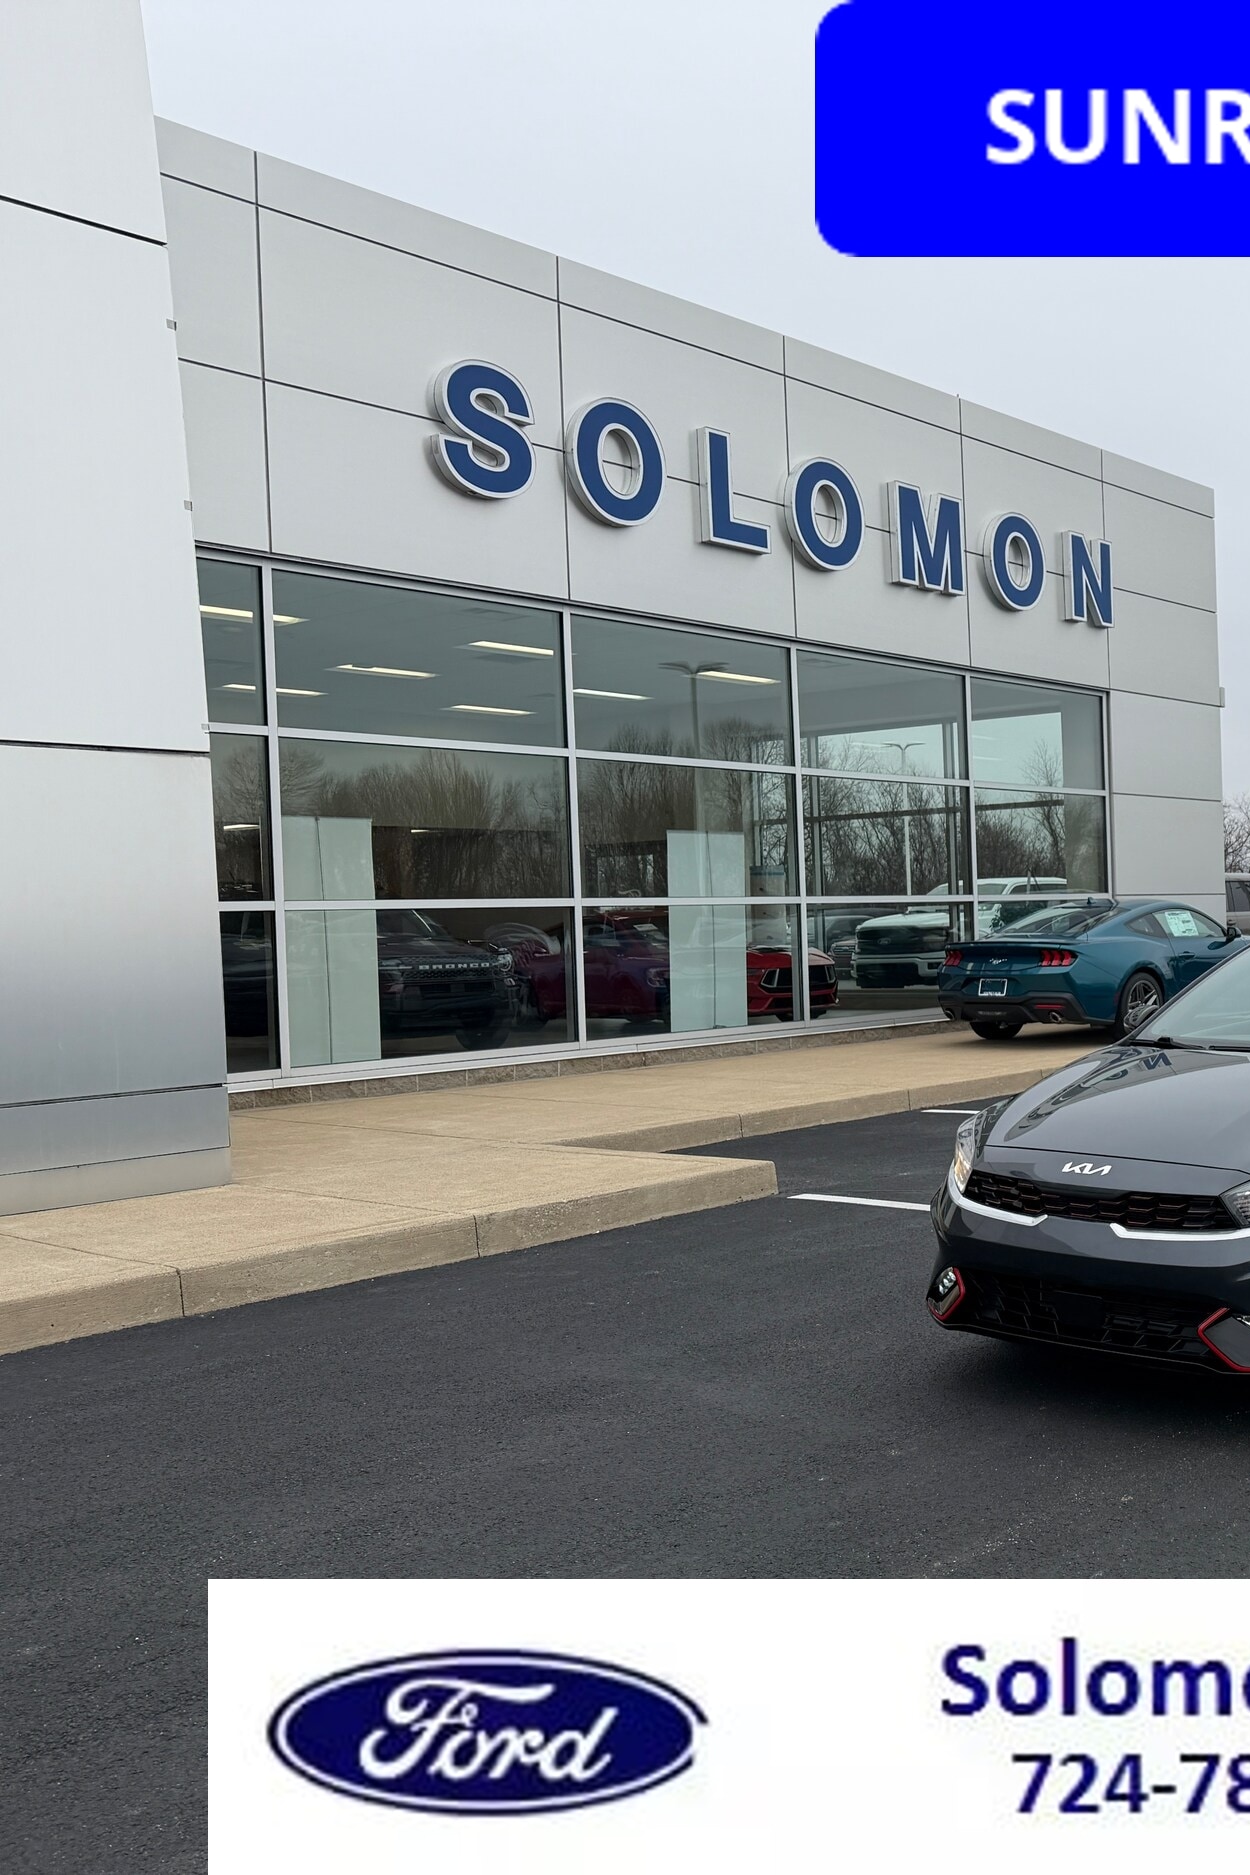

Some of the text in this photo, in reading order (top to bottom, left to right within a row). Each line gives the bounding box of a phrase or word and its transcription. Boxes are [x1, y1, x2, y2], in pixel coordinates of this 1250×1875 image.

[430, 358, 1115, 629] SOLOMON
[418, 962, 490, 970] BRONCO
[1061, 1161, 1113, 1176] KIA
